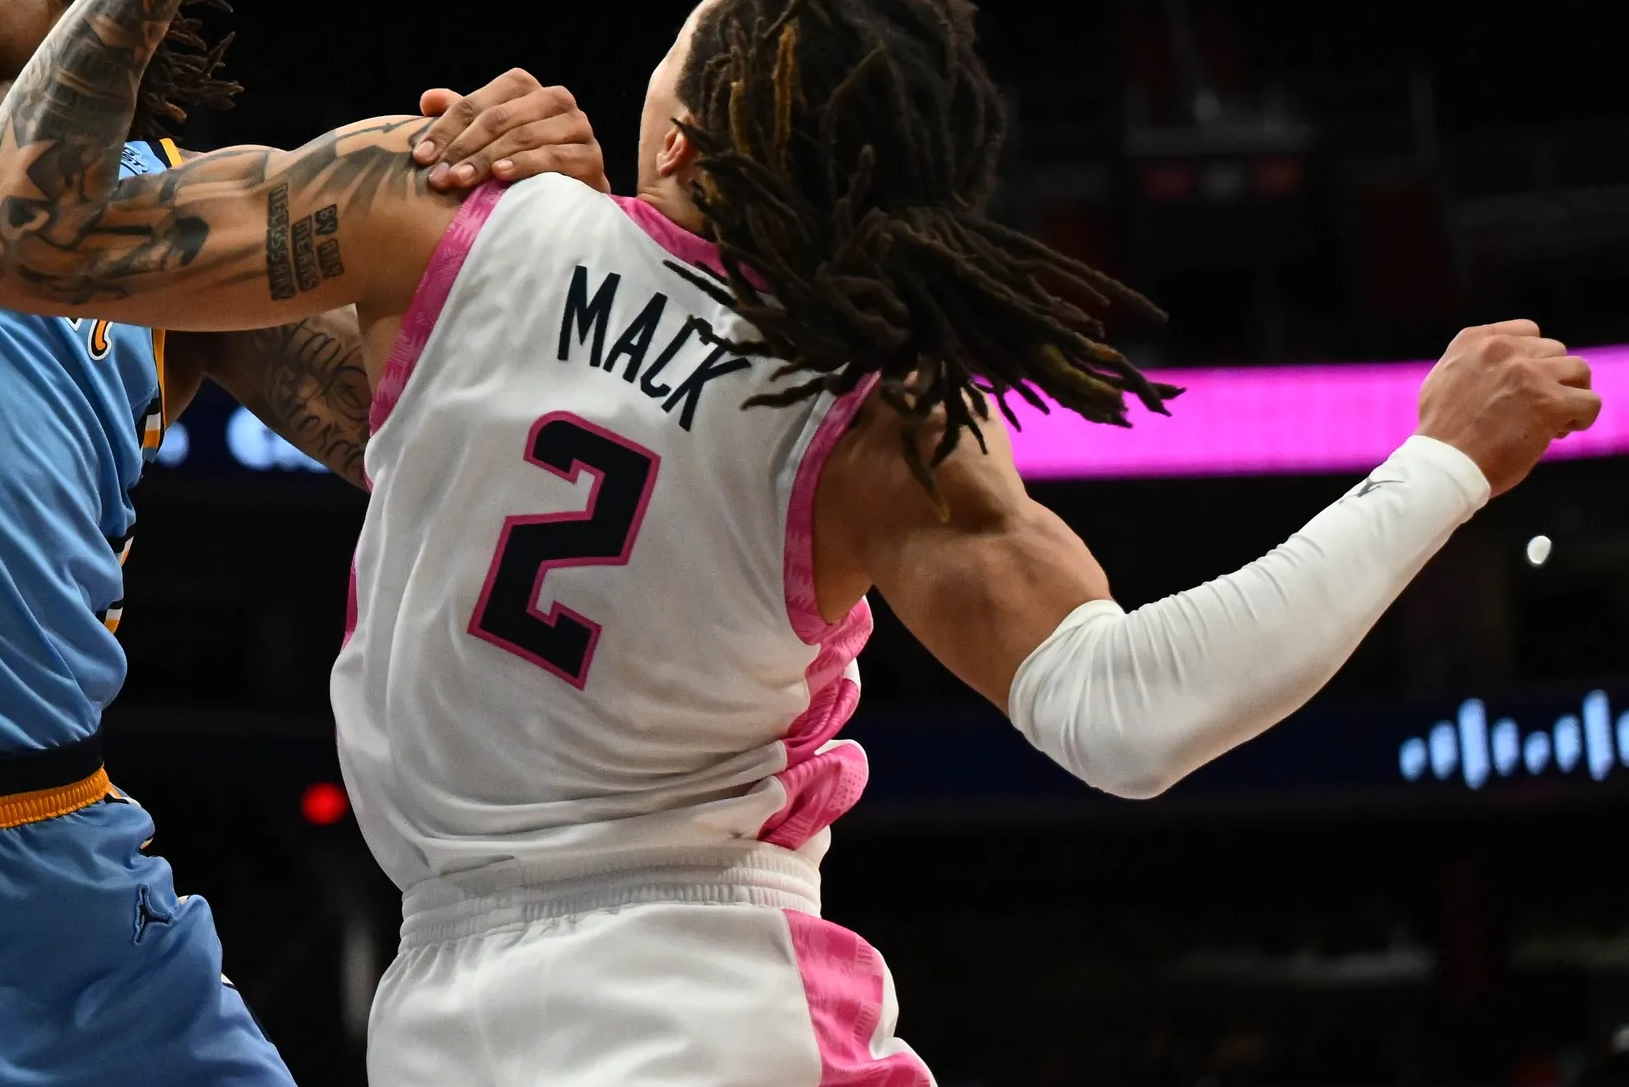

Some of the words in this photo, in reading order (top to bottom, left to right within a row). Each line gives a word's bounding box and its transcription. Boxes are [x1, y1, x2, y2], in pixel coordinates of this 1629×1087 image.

[315, 204, 338, 235] BY
[557, 264, 752, 432] MACK
[468, 410, 661, 690] 2
